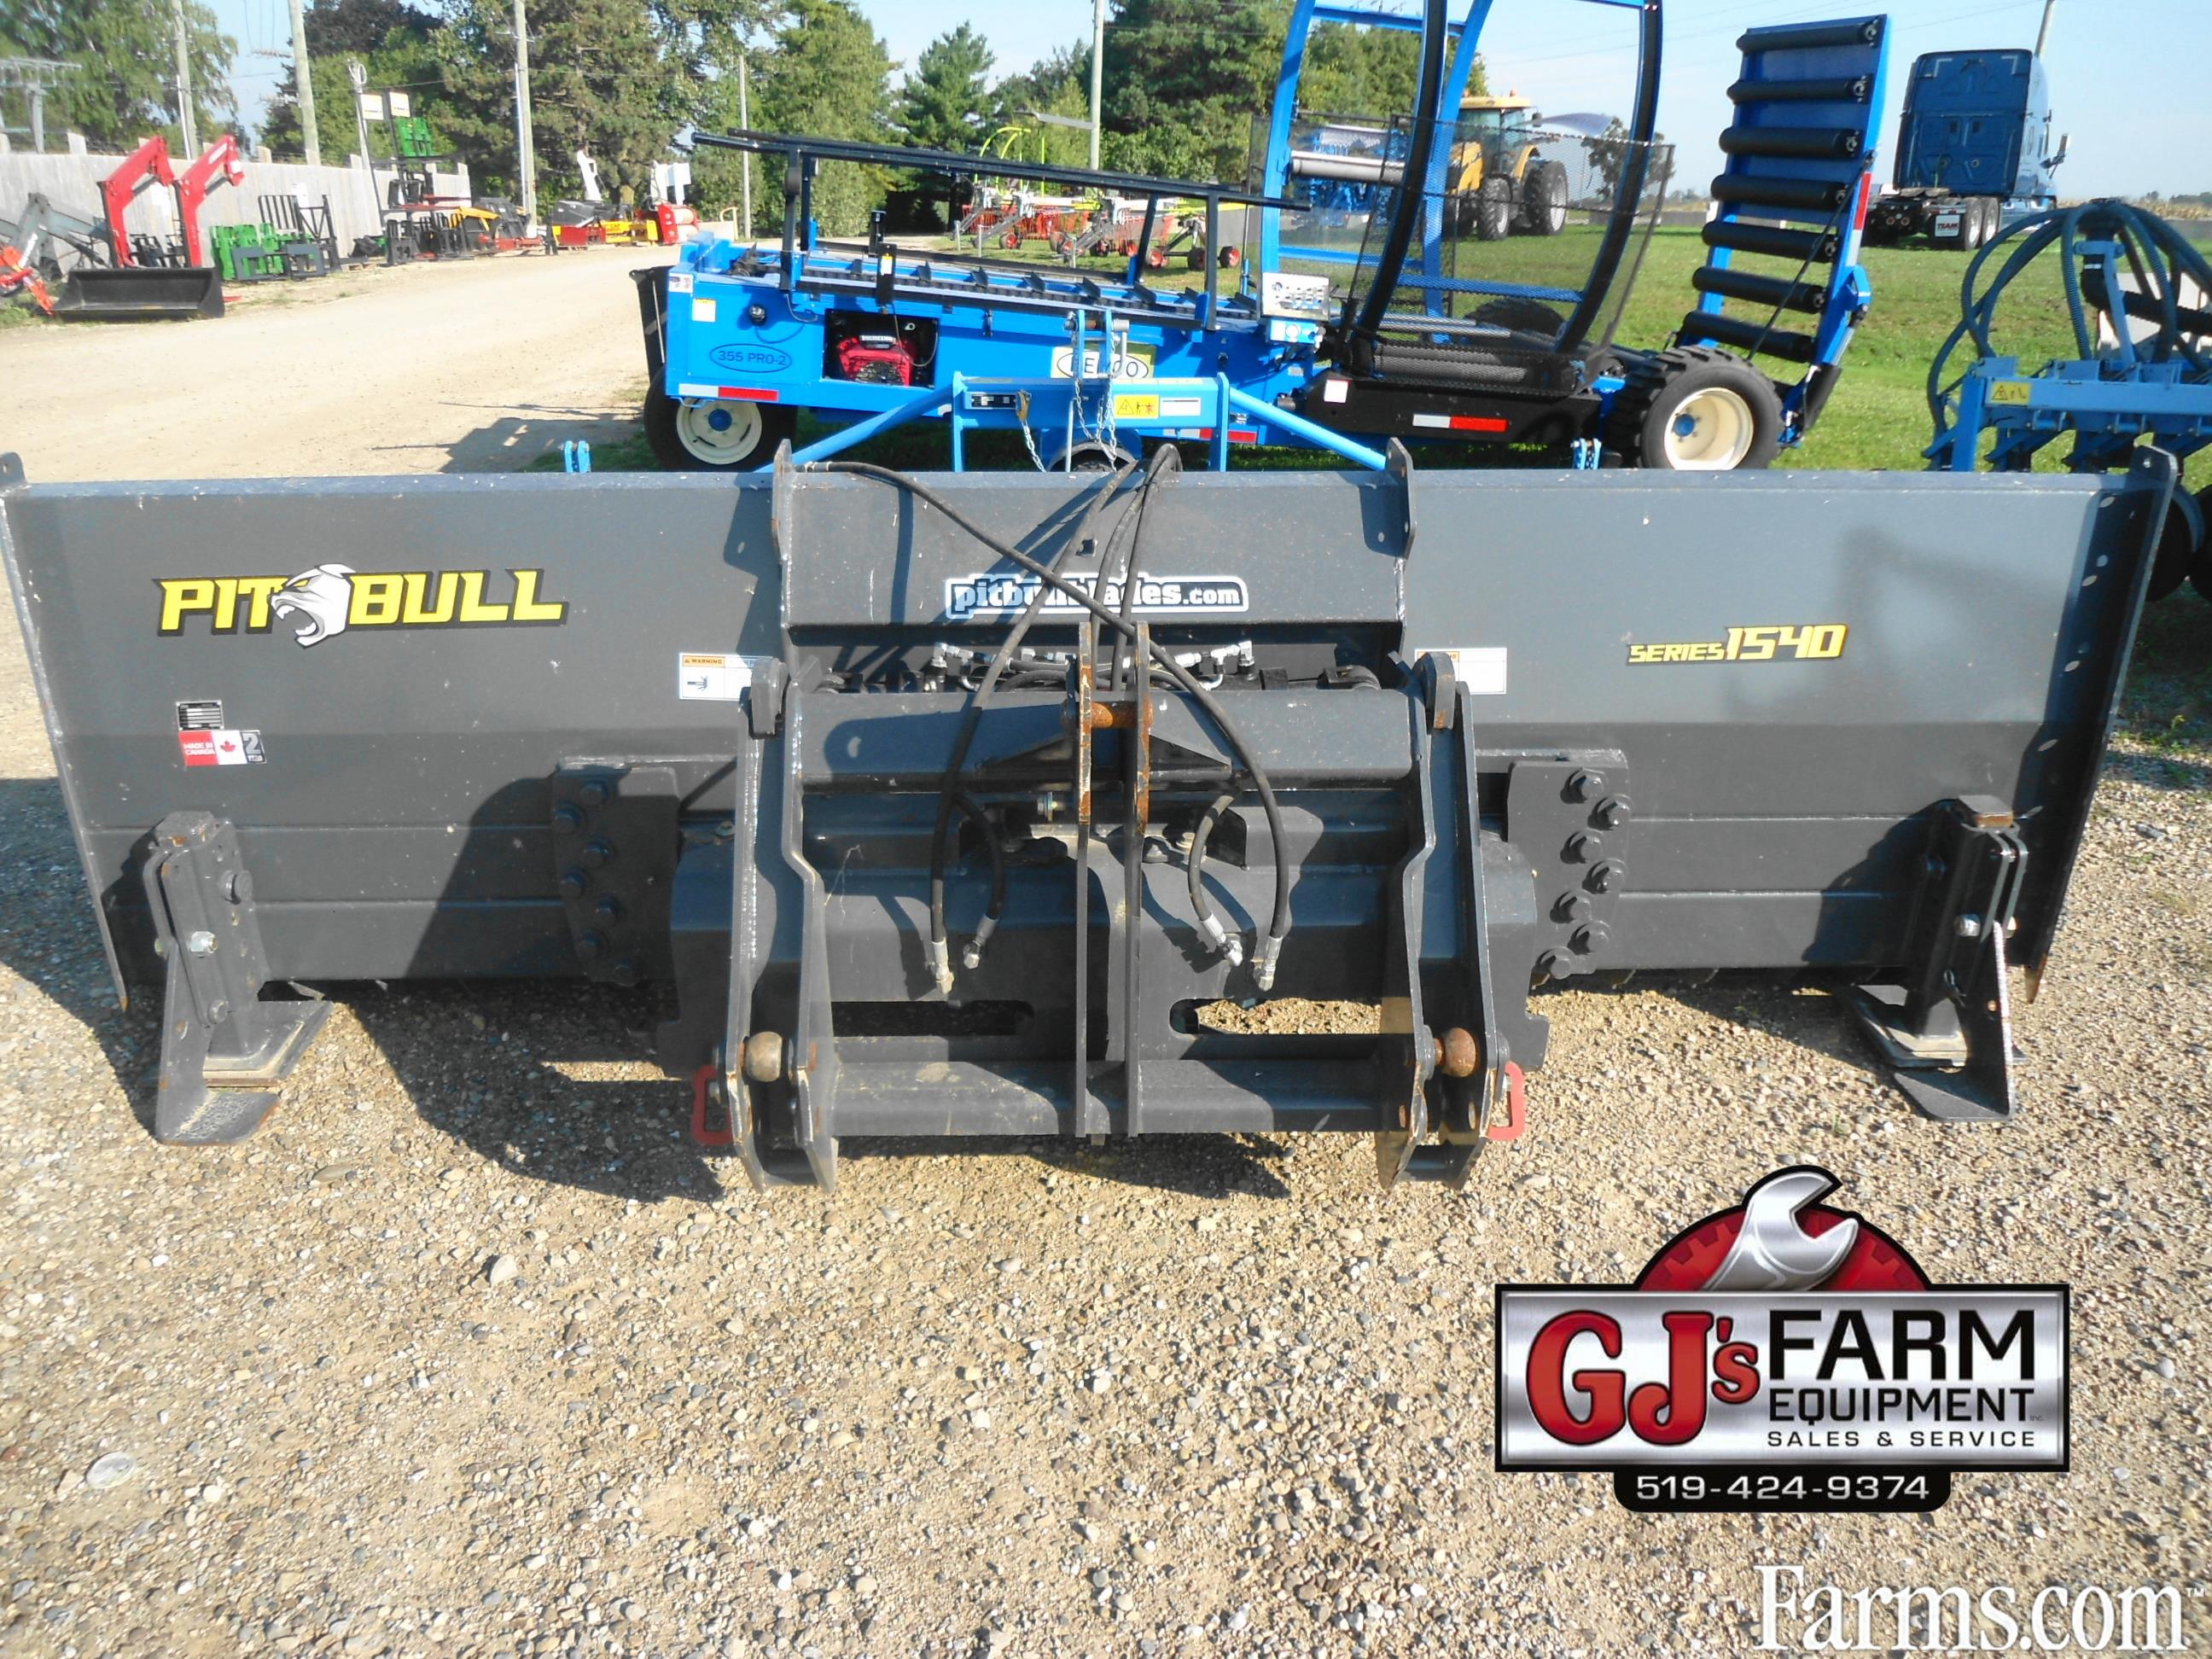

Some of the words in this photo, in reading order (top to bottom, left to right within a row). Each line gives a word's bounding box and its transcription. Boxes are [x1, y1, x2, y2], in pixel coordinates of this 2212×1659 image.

[718, 350, 743, 362] 355
[748, 352, 786, 365] PRO-2
[156, 575, 288, 632] PIT
[346, 568, 567, 628] BULL
[1627, 643, 1726, 663] SERIES
[1726, 625, 1847, 661] 1540
[242, 733, 261, 754] 2
